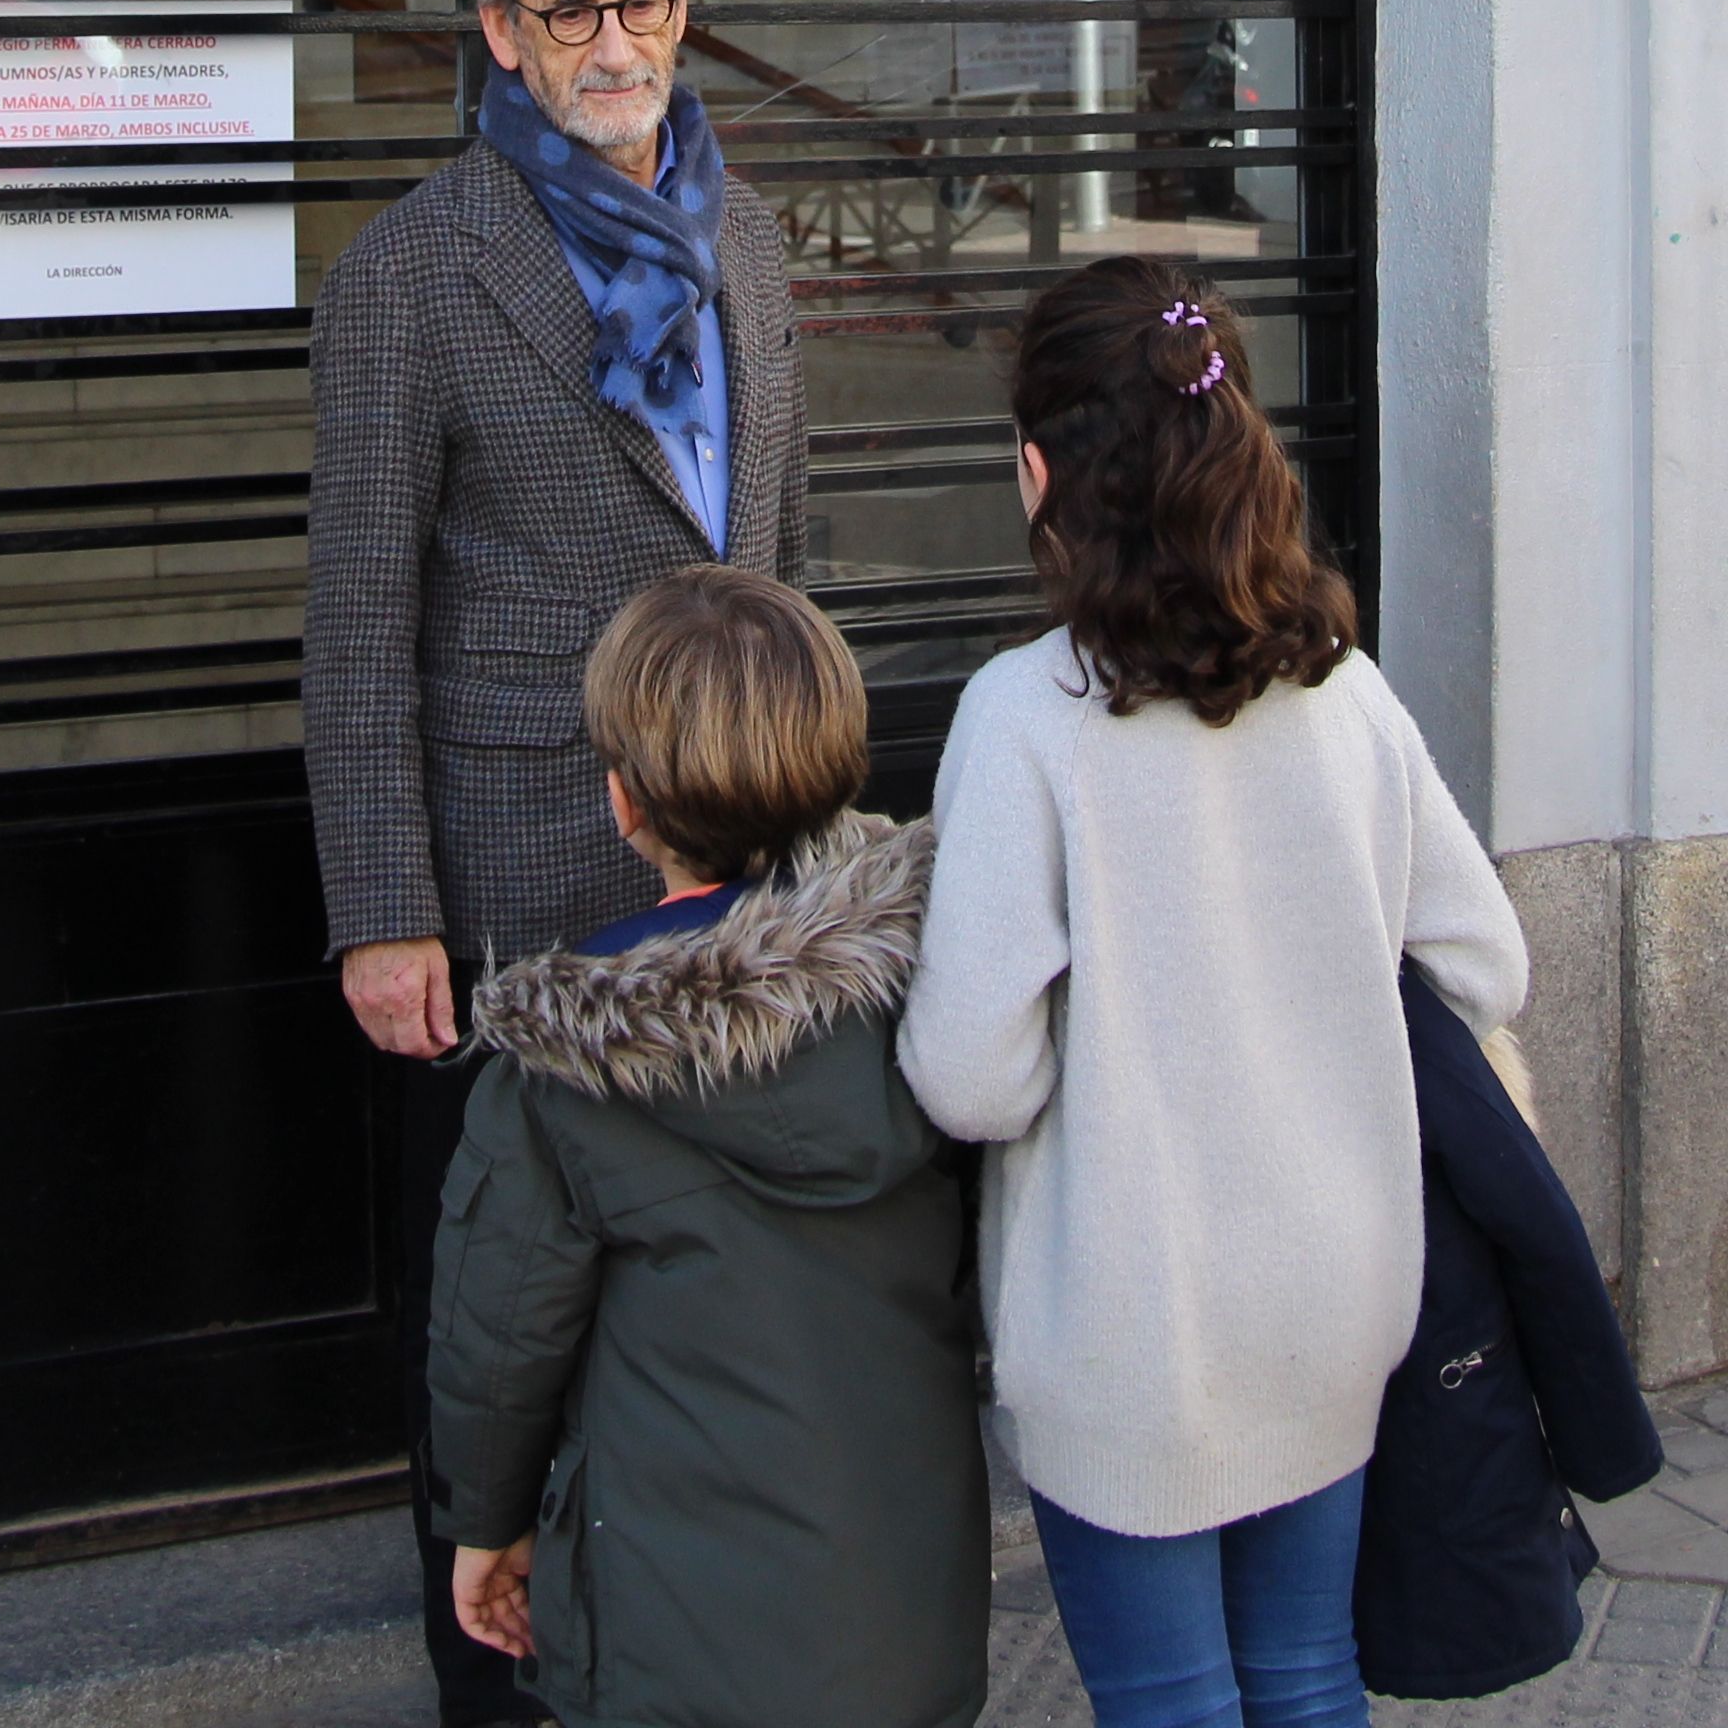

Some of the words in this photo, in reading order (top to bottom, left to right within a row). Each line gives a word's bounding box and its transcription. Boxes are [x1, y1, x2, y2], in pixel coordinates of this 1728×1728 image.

[147, 35, 216, 49] CERRADO
[86, 66, 95, 79] Y
[100, 64, 229, 81] PADRES/MADRES,
[2, 92, 75, 111] MAÑANA,
[80, 91, 105, 108] DÍA
[110, 95, 126, 107] 11
[131, 94, 149, 107] DE
[154, 93, 212, 109] MARZO,
[10, 125, 27, 138] 25
[32, 125, 51, 138] DE
[56, 123, 114, 140] MARZO,
[119, 122, 172, 137] AMBOS
[177, 120, 255, 135] INCLUSIVE.
[57, 211, 76, 225] DE
[80, 210, 115, 223] ESTA
[119, 208, 172, 222] MISMA
[175, 206, 234, 221] FORMA.
[46, 267, 60, 279] LA
[63, 264, 123, 278] DIRECCIÓN
